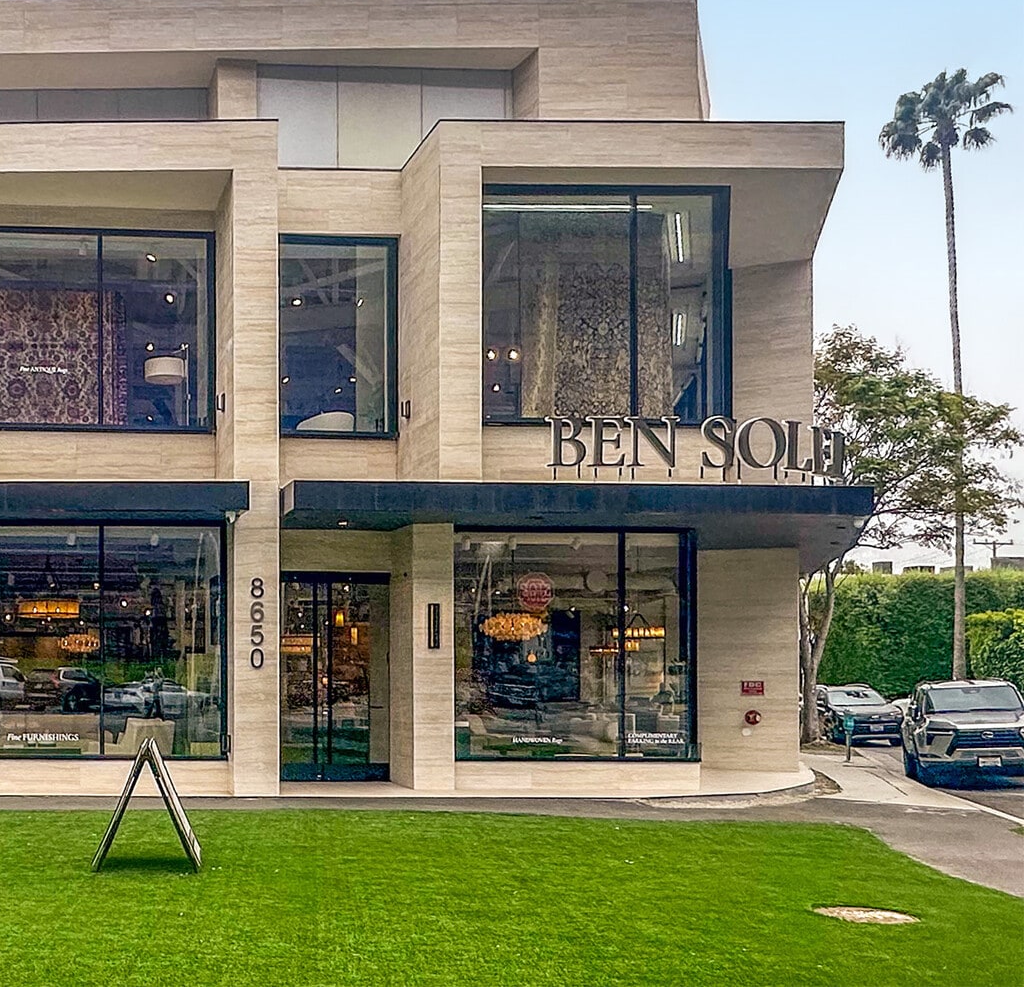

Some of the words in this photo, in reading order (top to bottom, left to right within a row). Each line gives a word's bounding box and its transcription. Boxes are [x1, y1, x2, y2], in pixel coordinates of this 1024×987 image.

[545, 415, 681, 467] BEN
[250, 577, 265, 669] 8650
[22, 733, 79, 741] FURNISHINGS
